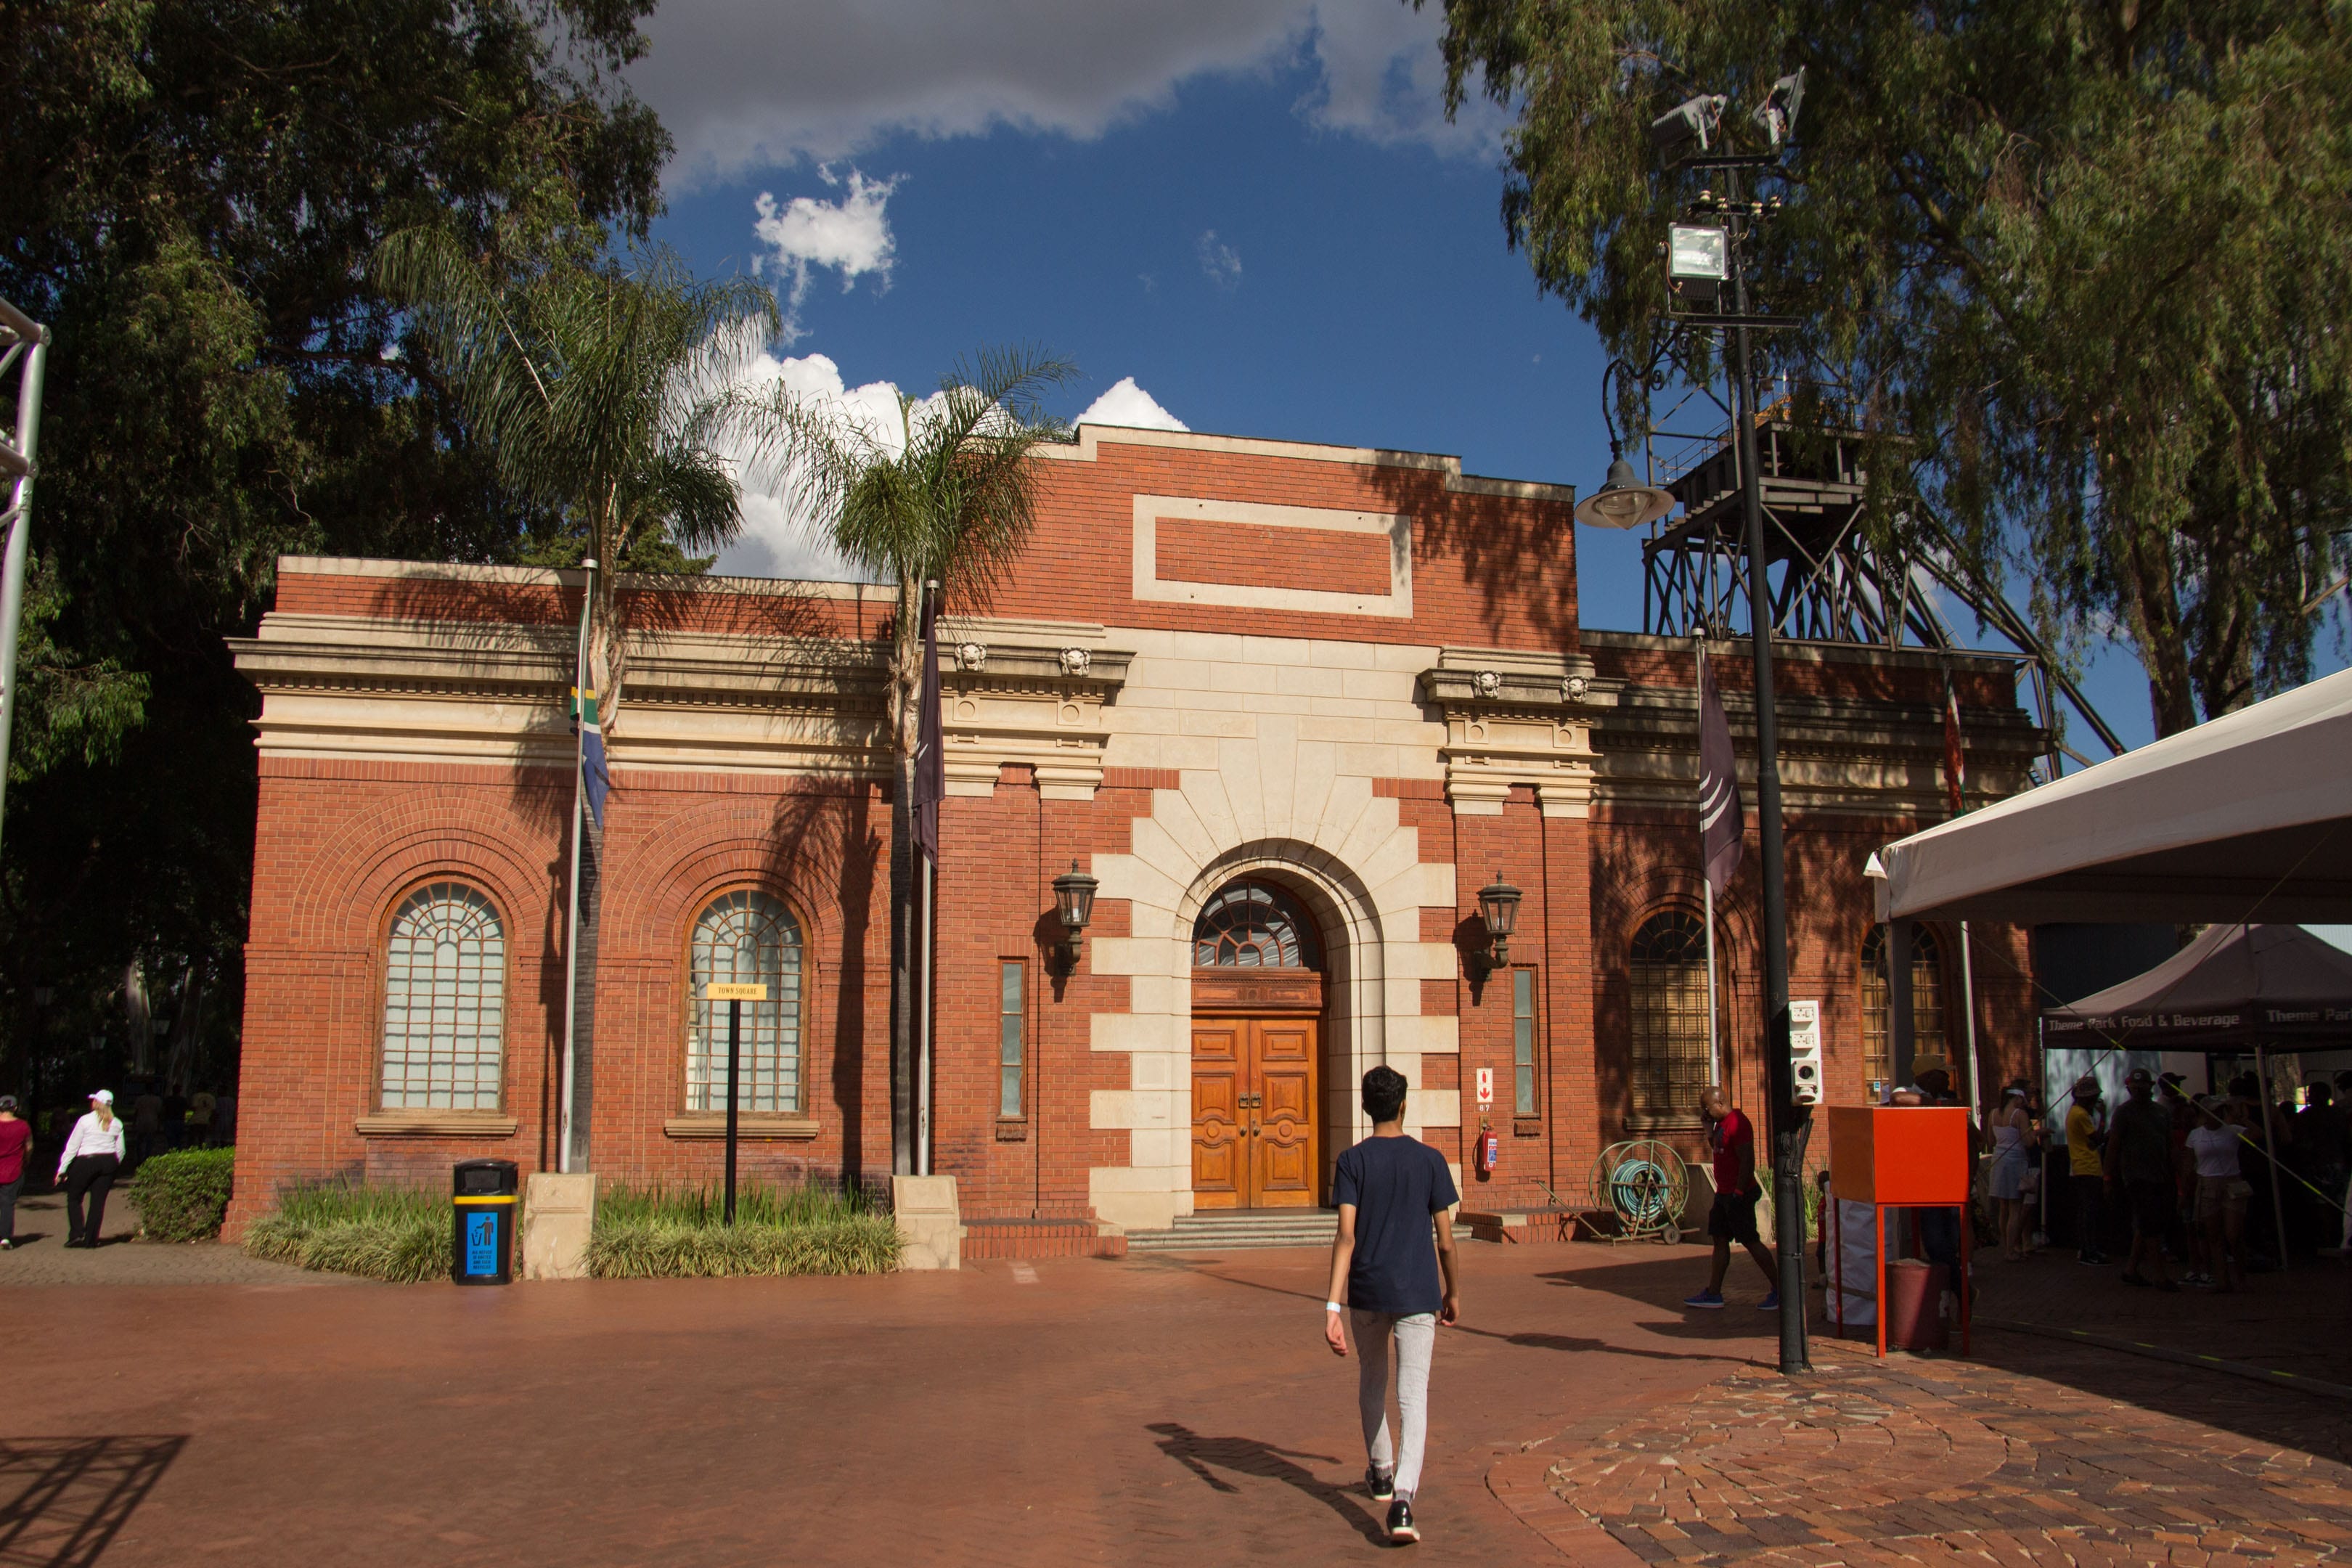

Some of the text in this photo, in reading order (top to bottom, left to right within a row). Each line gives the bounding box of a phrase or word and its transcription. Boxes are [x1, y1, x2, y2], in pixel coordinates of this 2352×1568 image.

[2049, 1013, 2240, 1031] Theme Park Food & Beverage
[2266, 1008, 2352, 1023] Theme Par
